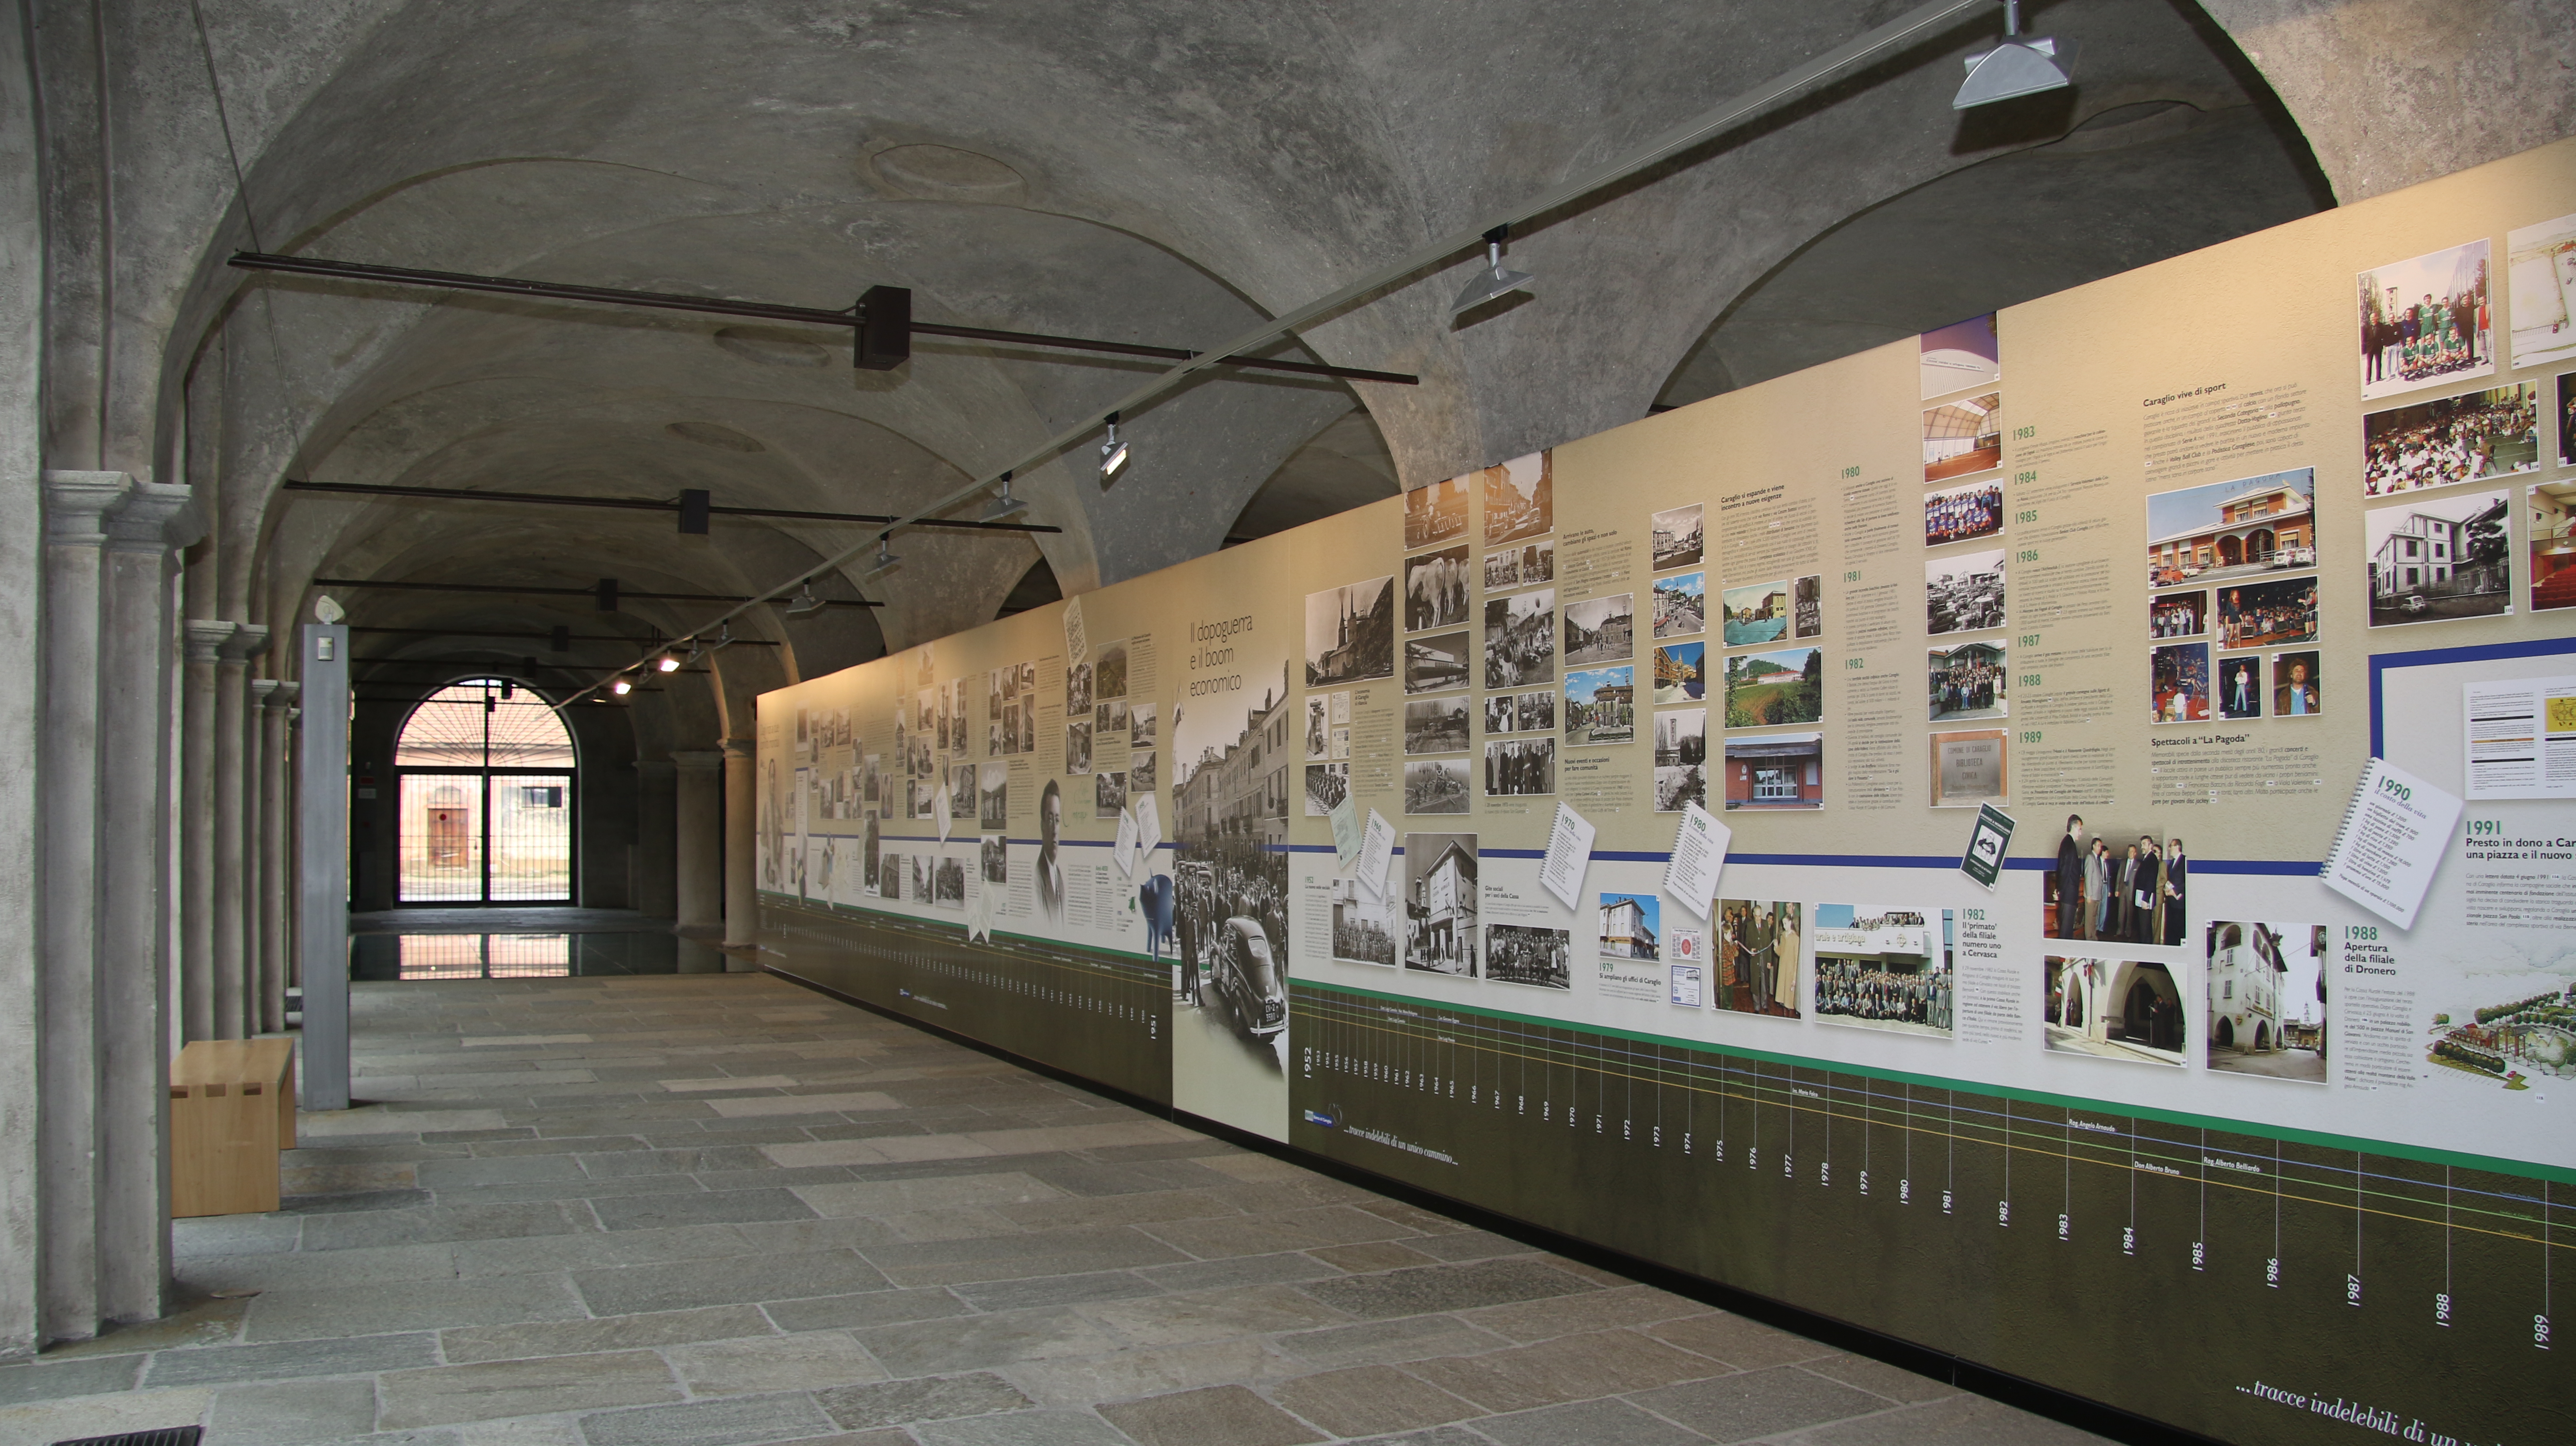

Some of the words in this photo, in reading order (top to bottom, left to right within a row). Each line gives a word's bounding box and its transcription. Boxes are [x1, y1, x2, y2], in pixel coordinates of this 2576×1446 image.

[2143, 395, 2175, 407] Caraglio
[2177, 391, 2192, 400] vive
[2195, 387, 2202, 395] di
[2204, 383, 2226, 395] sport
[2013, 426, 2035, 442] 1983
[1841, 466, 1860, 480] 1980
[2014, 471, 2037, 485] 1984
[1721, 494, 1740, 505] Caraglio
[1746, 488, 1766, 500] espande
[1771, 484, 1785, 492] viene
[1721, 502, 1741, 511] incontro
[1746, 498, 1760, 507] nuove
[1761, 493, 1782, 505] esigenze
[2015, 510, 2037, 524] 1985
[2016, 549, 2038, 563] 1986
[1844, 570, 1860, 583] 1981
[1191, 622, 1194, 643] Il
[1197, 615, 1253, 646] dopoguerra
[2018, 634, 2040, 648] 1987
[1190, 655, 1196, 670] e
[1199, 647, 1202, 668] il
[1206, 646, 1233, 667] boom
[1845, 658, 1863, 670] 1982
[1190, 669, 1241, 697] economico
[2019, 674, 2041, 687] 1988
[2020, 731, 2042, 744] 1989
[2151, 737, 2190, 748] Spettacoli
[2198, 736, 2213, 744] “La
[2215, 734, 2250, 745] Pagoda”
[1948, 747, 1964, 755] COMUNE
[1972, 745, 1991, 753] CARAGLIO
[1956, 758, 1983, 768] BIBLIOTECA
[1962, 771, 1977, 780] CIVICA
[2377, 776, 2411, 801] 1990
[2380, 792, 2396, 804] costo
[2397, 800, 2413, 812] della
[2414, 809, 2427, 819] vita
[1561, 813, 1575, 830] 1970
[1690, 814, 1706, 832] 1980
[2466, 820, 2501, 835] 1991
[2466, 838, 2499, 847] Presto
[2503, 838, 2512, 847] in
[2516, 838, 2543, 847] dono
[2487, 850, 2519, 861] piazza
[2531, 850, 2537, 859] il
[1963, 908, 1985, 920] 1982
[2344, 926, 2378, 940] 1988
[1968, 950, 1997, 958] Cervasca
[2344, 942, 2388, 953] Apertura
[2345, 954, 2367, 962] della
[2369, 954, 2395, 964] filiale
[1599, 963, 1614, 972] 1979
[2345, 965, 2353, 973] di
[2356, 965, 2396, 975] Dronero
[1604, 974, 1622, 982] ampliano
[1644, 978, 1662, 987] Caraglio
[2069, 1119, 2079, 1127] Rag.
[2079, 1121, 2095, 1130] Angelo
[2096, 1123, 2115, 1132] Arnaudo
[1365, 1128, 1390, 1145] indelebili
[1391, 1135, 1398, 1148] di
[1398, 1141, 1406, 1150] un
[1407, 1141, 1423, 1155] unico
[2146, 1164, 2163, 1172] Alberto
[2165, 1166, 2180, 1175] Bruno
[2204, 1157, 2215, 1166] Rag.
[2215, 1159, 2235, 1168] Alberto
[2236, 1162, 2260, 1173] Belliardo
[1860, 1171, 1868, 1195] 1979
[1900, 1179, 1908, 1205] 1980
[1943, 1190, 1951, 1214] 1981
[1999, 1201, 2008, 1227] 1982
[2059, 1213, 2068, 1241] 1983
[2123, 1227, 2133, 1255] 1984
[2192, 1242, 2203, 1271] 1985
[2267, 1258, 2278, 1288] 1986
[2347, 1274, 2360, 1306] 1987
[2436, 1293, 2449, 1327] 1988
[2534, 1314, 2549, 1350] 1989
[2310, 1392, 2398, 1436] indelebili
[2403, 1418, 2425, 1442] di
[2430, 1431, 2458, 1446] un
